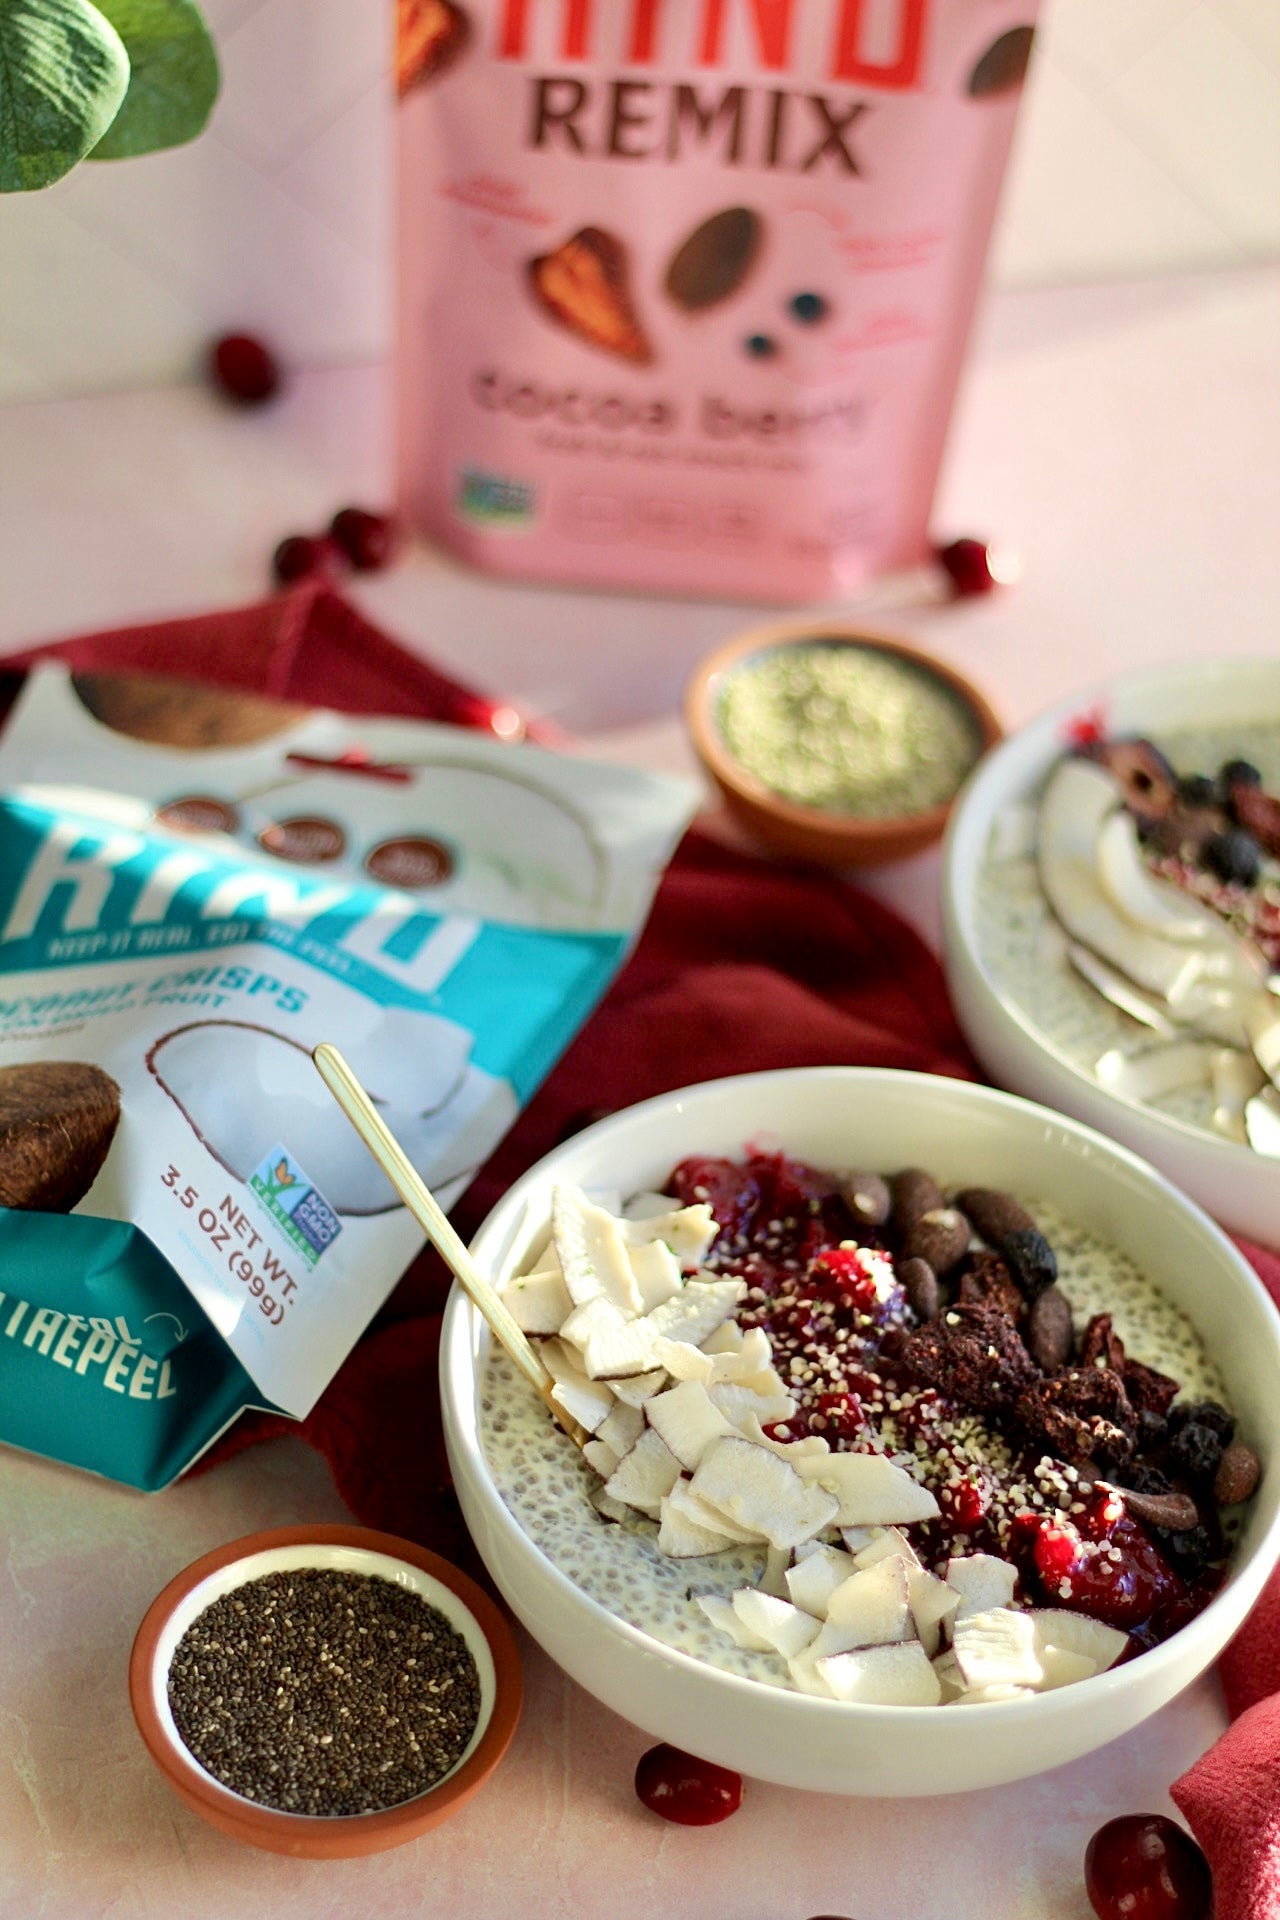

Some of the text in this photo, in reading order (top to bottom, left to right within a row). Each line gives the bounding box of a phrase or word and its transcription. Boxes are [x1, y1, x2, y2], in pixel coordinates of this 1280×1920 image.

[529, 76, 868, 178] REMIX
[160, 1163, 200, 1210] 3.5
[198, 1207, 232, 1253] OZ
[228, 1249, 286, 1326] (99g)
[219, 1193, 264, 1250] NET
[262, 1247, 298, 1306] WT.
[253, 1179, 317, 1260] VERIFIED
[299, 1203, 331, 1242] GMO
